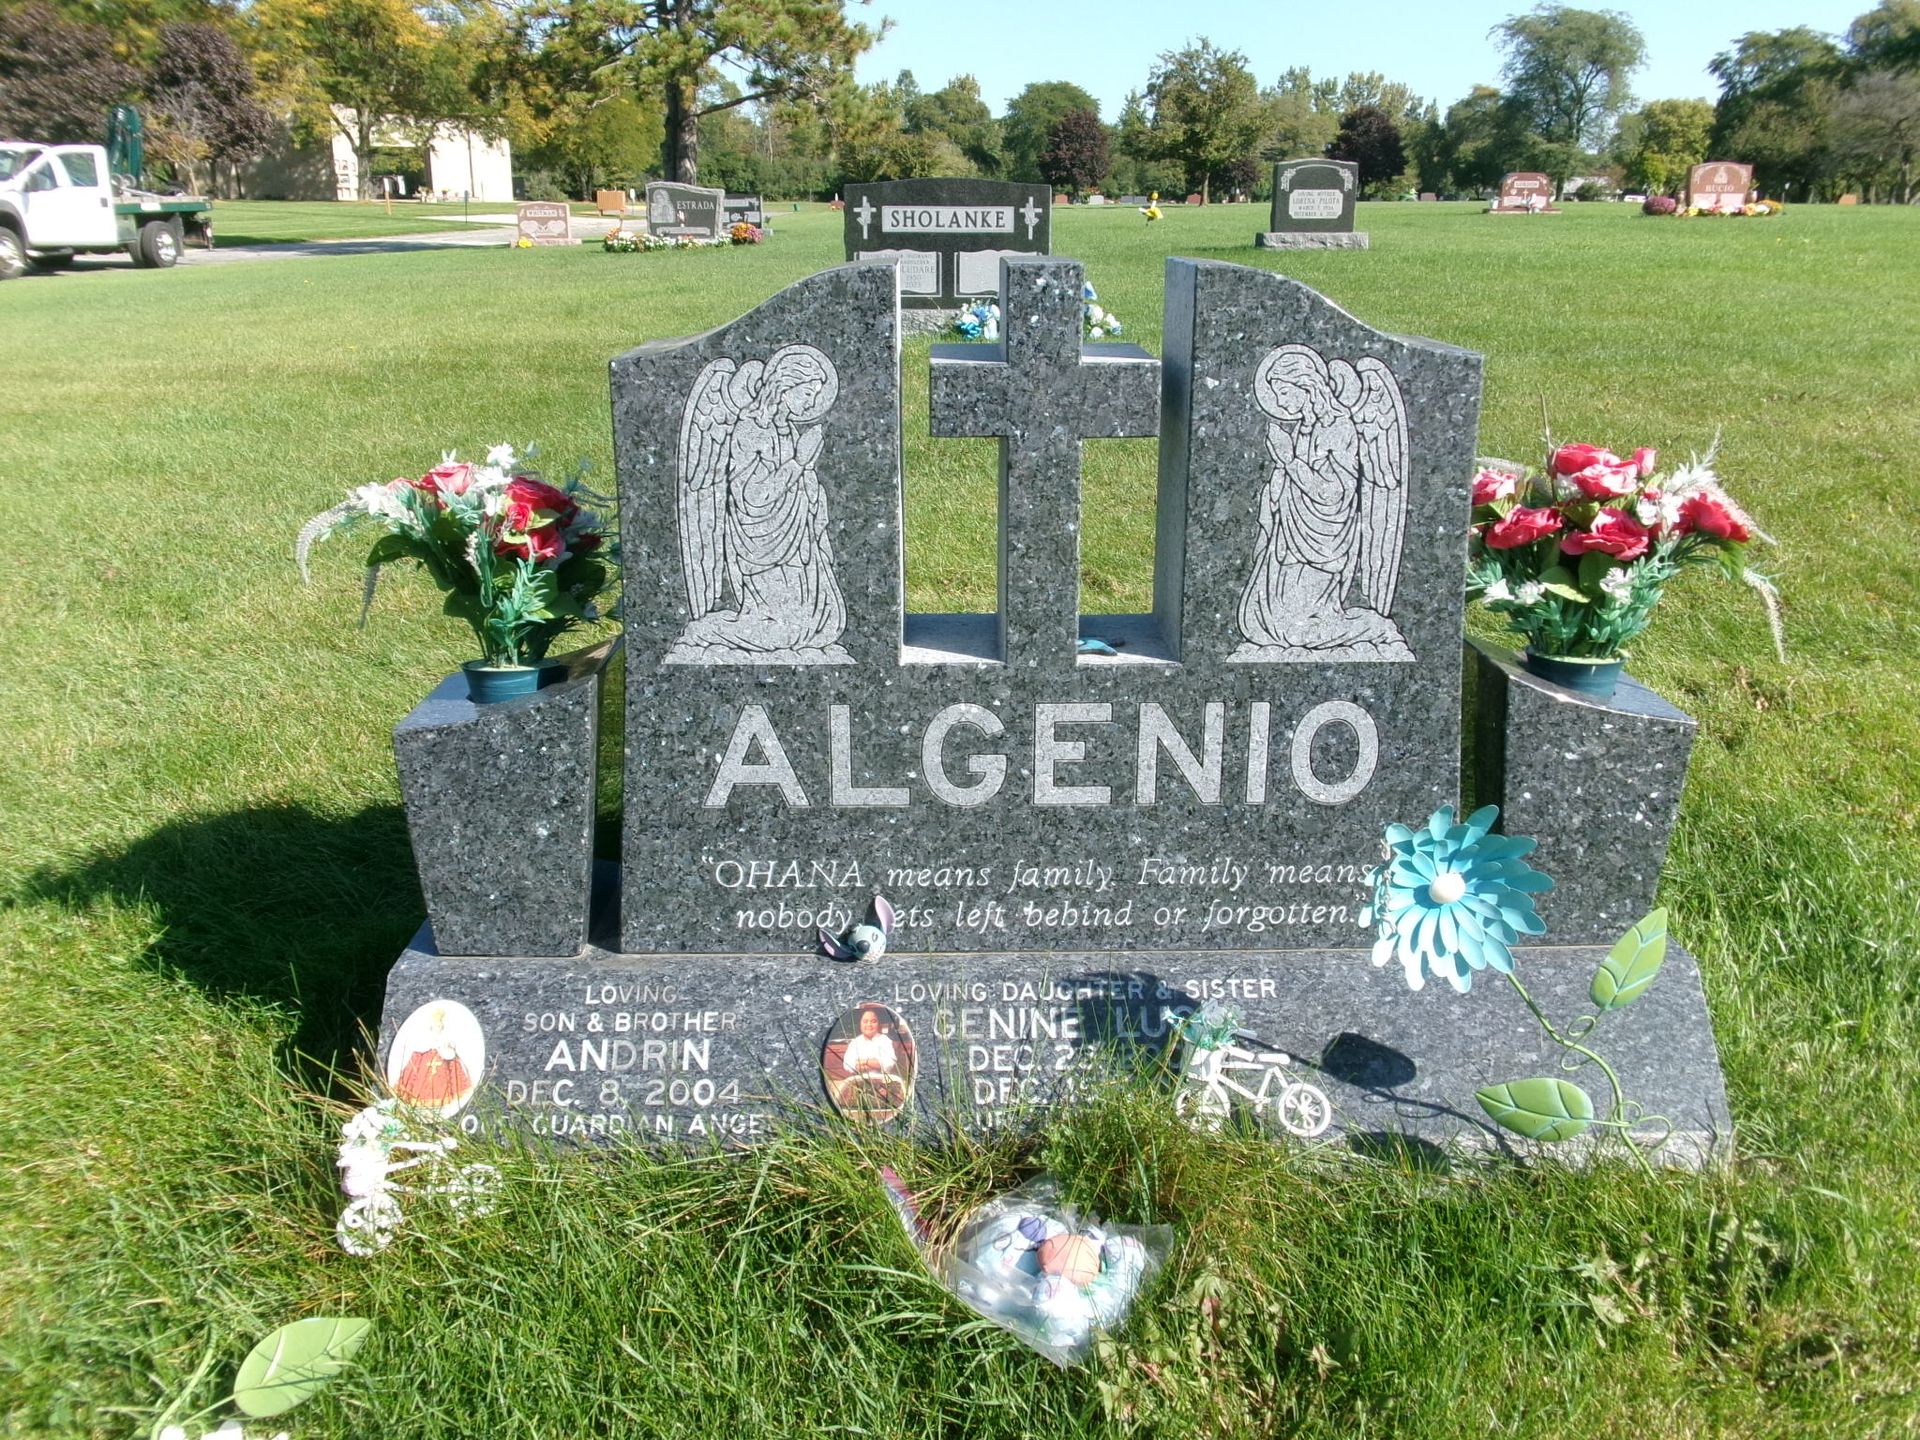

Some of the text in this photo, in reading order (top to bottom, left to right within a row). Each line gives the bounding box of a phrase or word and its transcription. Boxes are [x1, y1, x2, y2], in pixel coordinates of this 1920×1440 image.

[676, 201, 715, 210] ESTRADA
[890, 210, 1006, 229] SHOLANKE
[702, 701, 1380, 808] ALGENIO
[887, 866, 991, 887] means
[1137, 857, 1248, 892] Family
[1269, 863, 1374, 884] means
[736, 902, 852, 935] nobody
[888, 907, 935, 928] ets
[955, 901, 1006, 934] left
[1024, 900, 1132, 927] behind
[1154, 906, 1188, 925] or
[584, 985, 677, 1005] LOVING
[895, 978, 1278, 1002] LOVING DAUGHTER & SISTER
[523, 1011, 737, 1032] SON & BROTHER
[932, 1006, 1083, 1040] GENINE
[544, 1038, 710, 1072] ANDRIN
[968, 1045, 1042, 1072] DEC.
[506, 1079, 580, 1106] DEC.
[644, 1078, 742, 1106] 2004
[687, 1113, 772, 1135] ANGE
